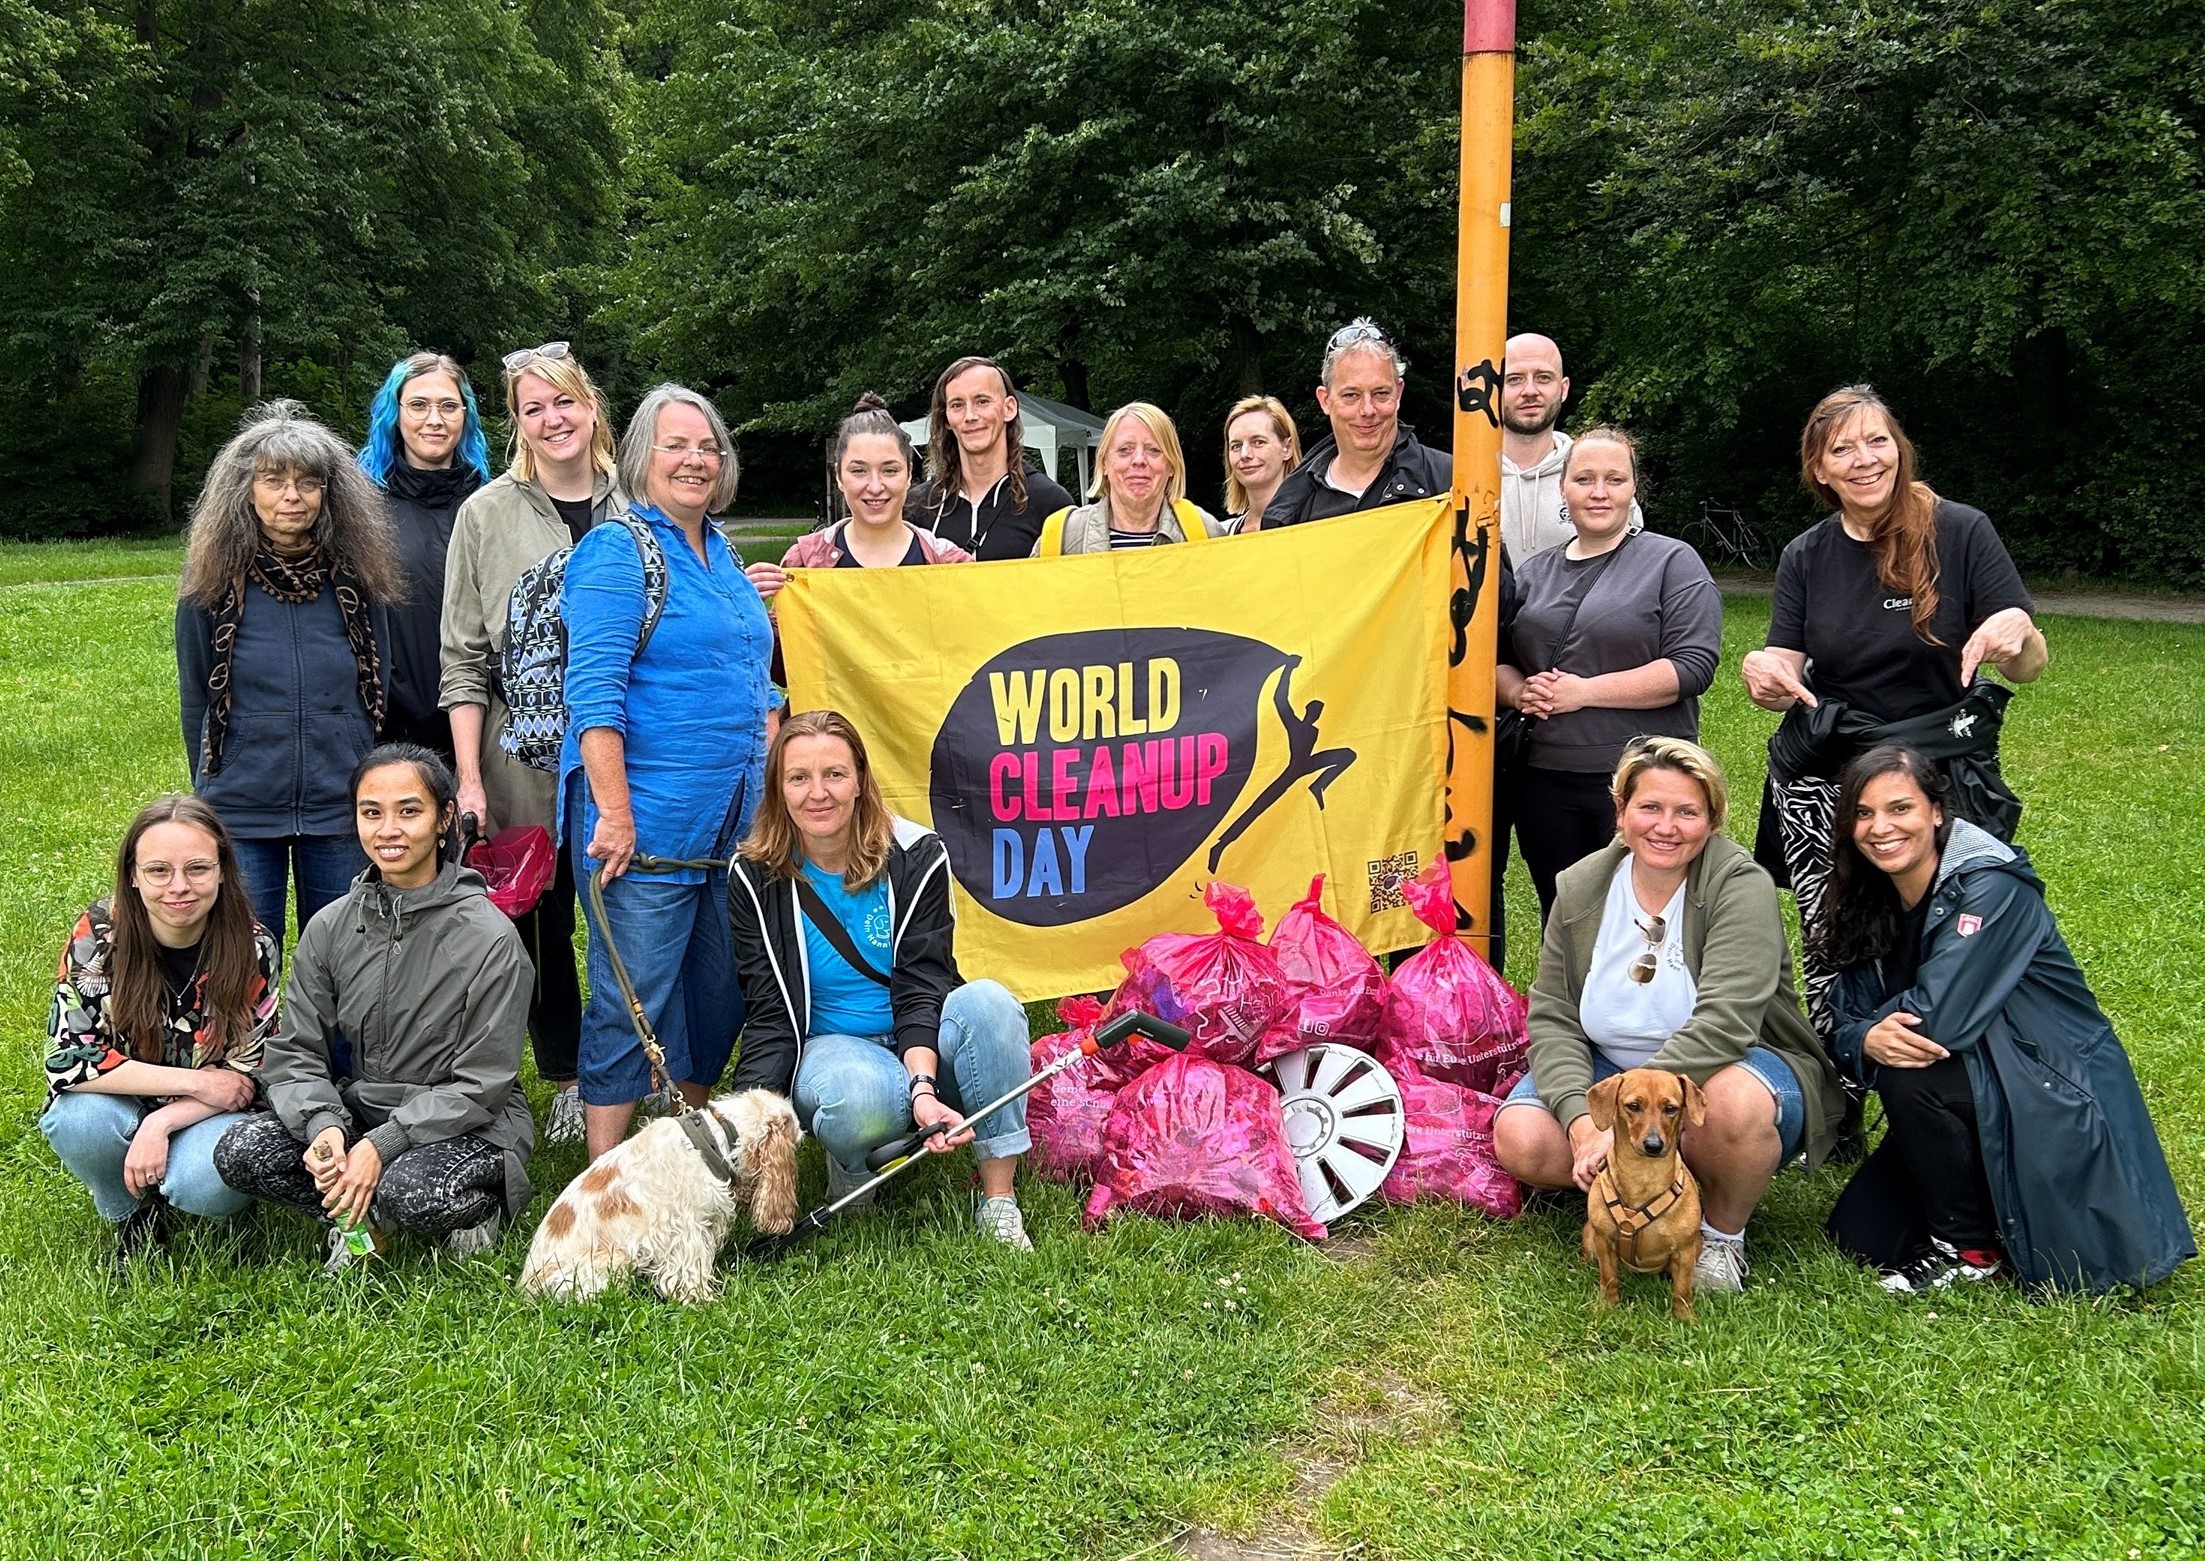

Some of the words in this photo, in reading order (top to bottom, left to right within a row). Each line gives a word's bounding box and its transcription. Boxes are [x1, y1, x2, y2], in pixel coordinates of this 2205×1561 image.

[989, 657, 1181, 746] WORLD
[990, 732, 1229, 822] CLEANUP
[992, 825, 1095, 900] DAY
[867, 934, 891, 948] Hann
[1425, 1051, 1441, 1064] für
[1443, 1053, 1466, 1066] Eue
[1051, 1097, 1076, 1107] eine
[1406, 1126, 1423, 1134] ure
